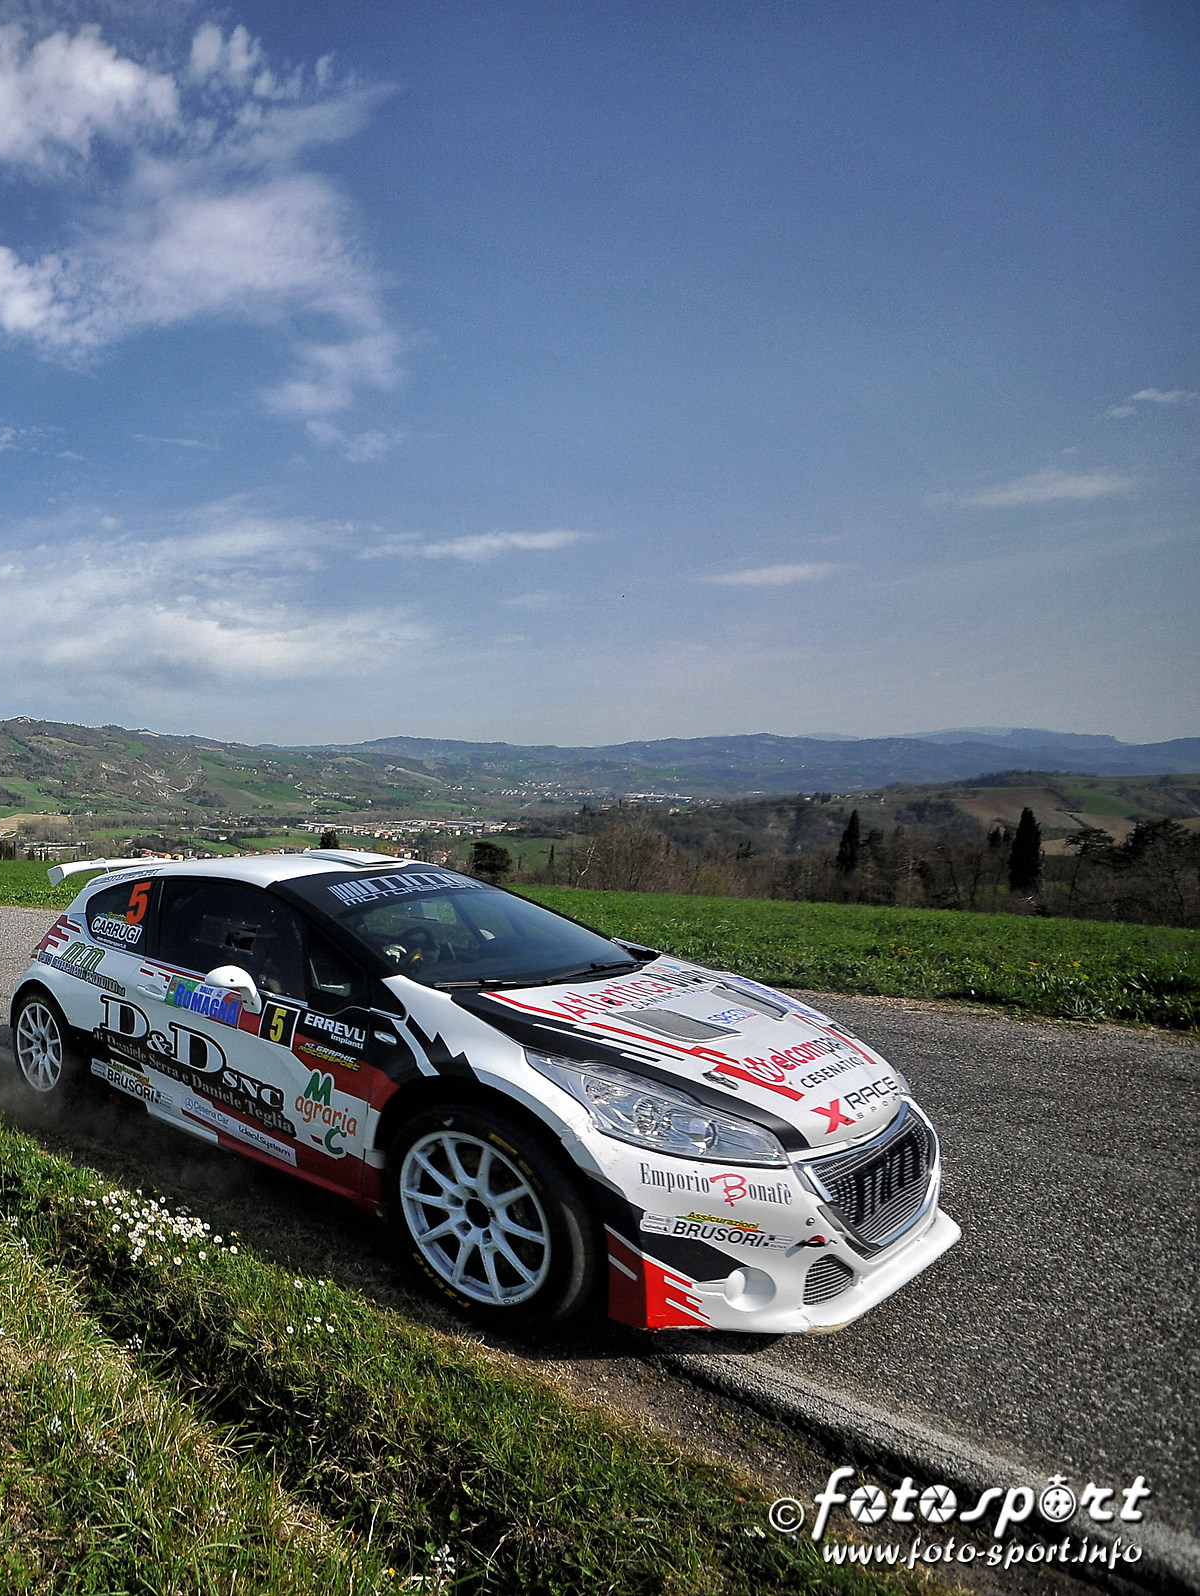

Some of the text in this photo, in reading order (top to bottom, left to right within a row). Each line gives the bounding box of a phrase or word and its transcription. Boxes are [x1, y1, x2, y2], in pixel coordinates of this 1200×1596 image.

[126, 881, 152, 926] 5
[92, 917, 141, 943] CARRUGI
[174, 983, 240, 1027] ROMAGNA
[100, 996, 226, 1075] D&D
[269, 1007, 287, 1042] 5
[304, 1013, 366, 1042] ERREVU
[316, 1045, 357, 1064] GRAPHIC
[106, 1034, 147, 1061] Daniele
[148, 1053, 180, 1079] Serra
[191, 1073, 242, 1109] Daniele
[244, 1098, 293, 1132] Teglia
[107, 1067, 155, 1103] BRUSORI
[801, 1056, 866, 1088] CESENATICO
[303, 1071, 332, 1107] M
[294, 1095, 358, 1136] agraria
[325, 1125, 348, 1155] C
[639, 1162, 710, 1194] Emporio
[672, 1220, 765, 1249] BRUSORI
[687, 1211, 760, 1229] Assicurazioni
